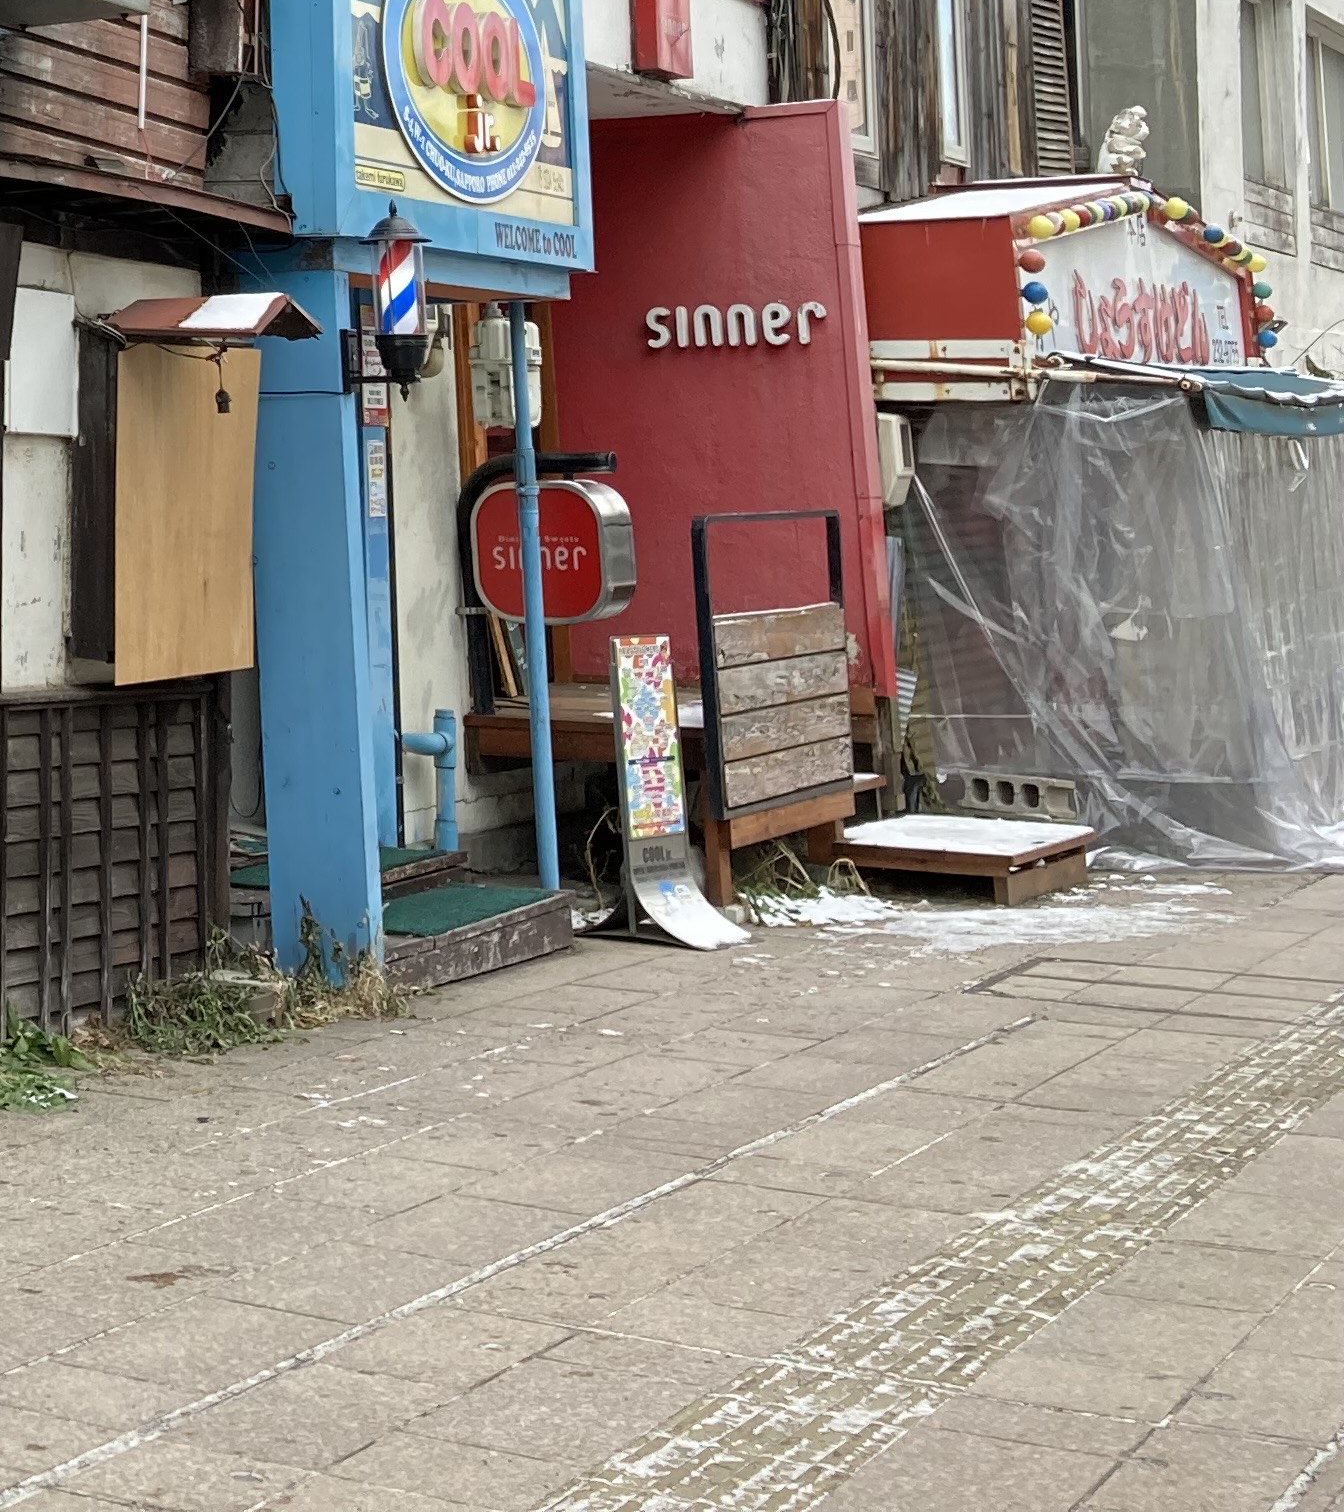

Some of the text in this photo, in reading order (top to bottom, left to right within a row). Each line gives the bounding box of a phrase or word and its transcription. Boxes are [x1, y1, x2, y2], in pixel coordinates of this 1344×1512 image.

[495, 222, 576, 260] WELCOME to COOL
